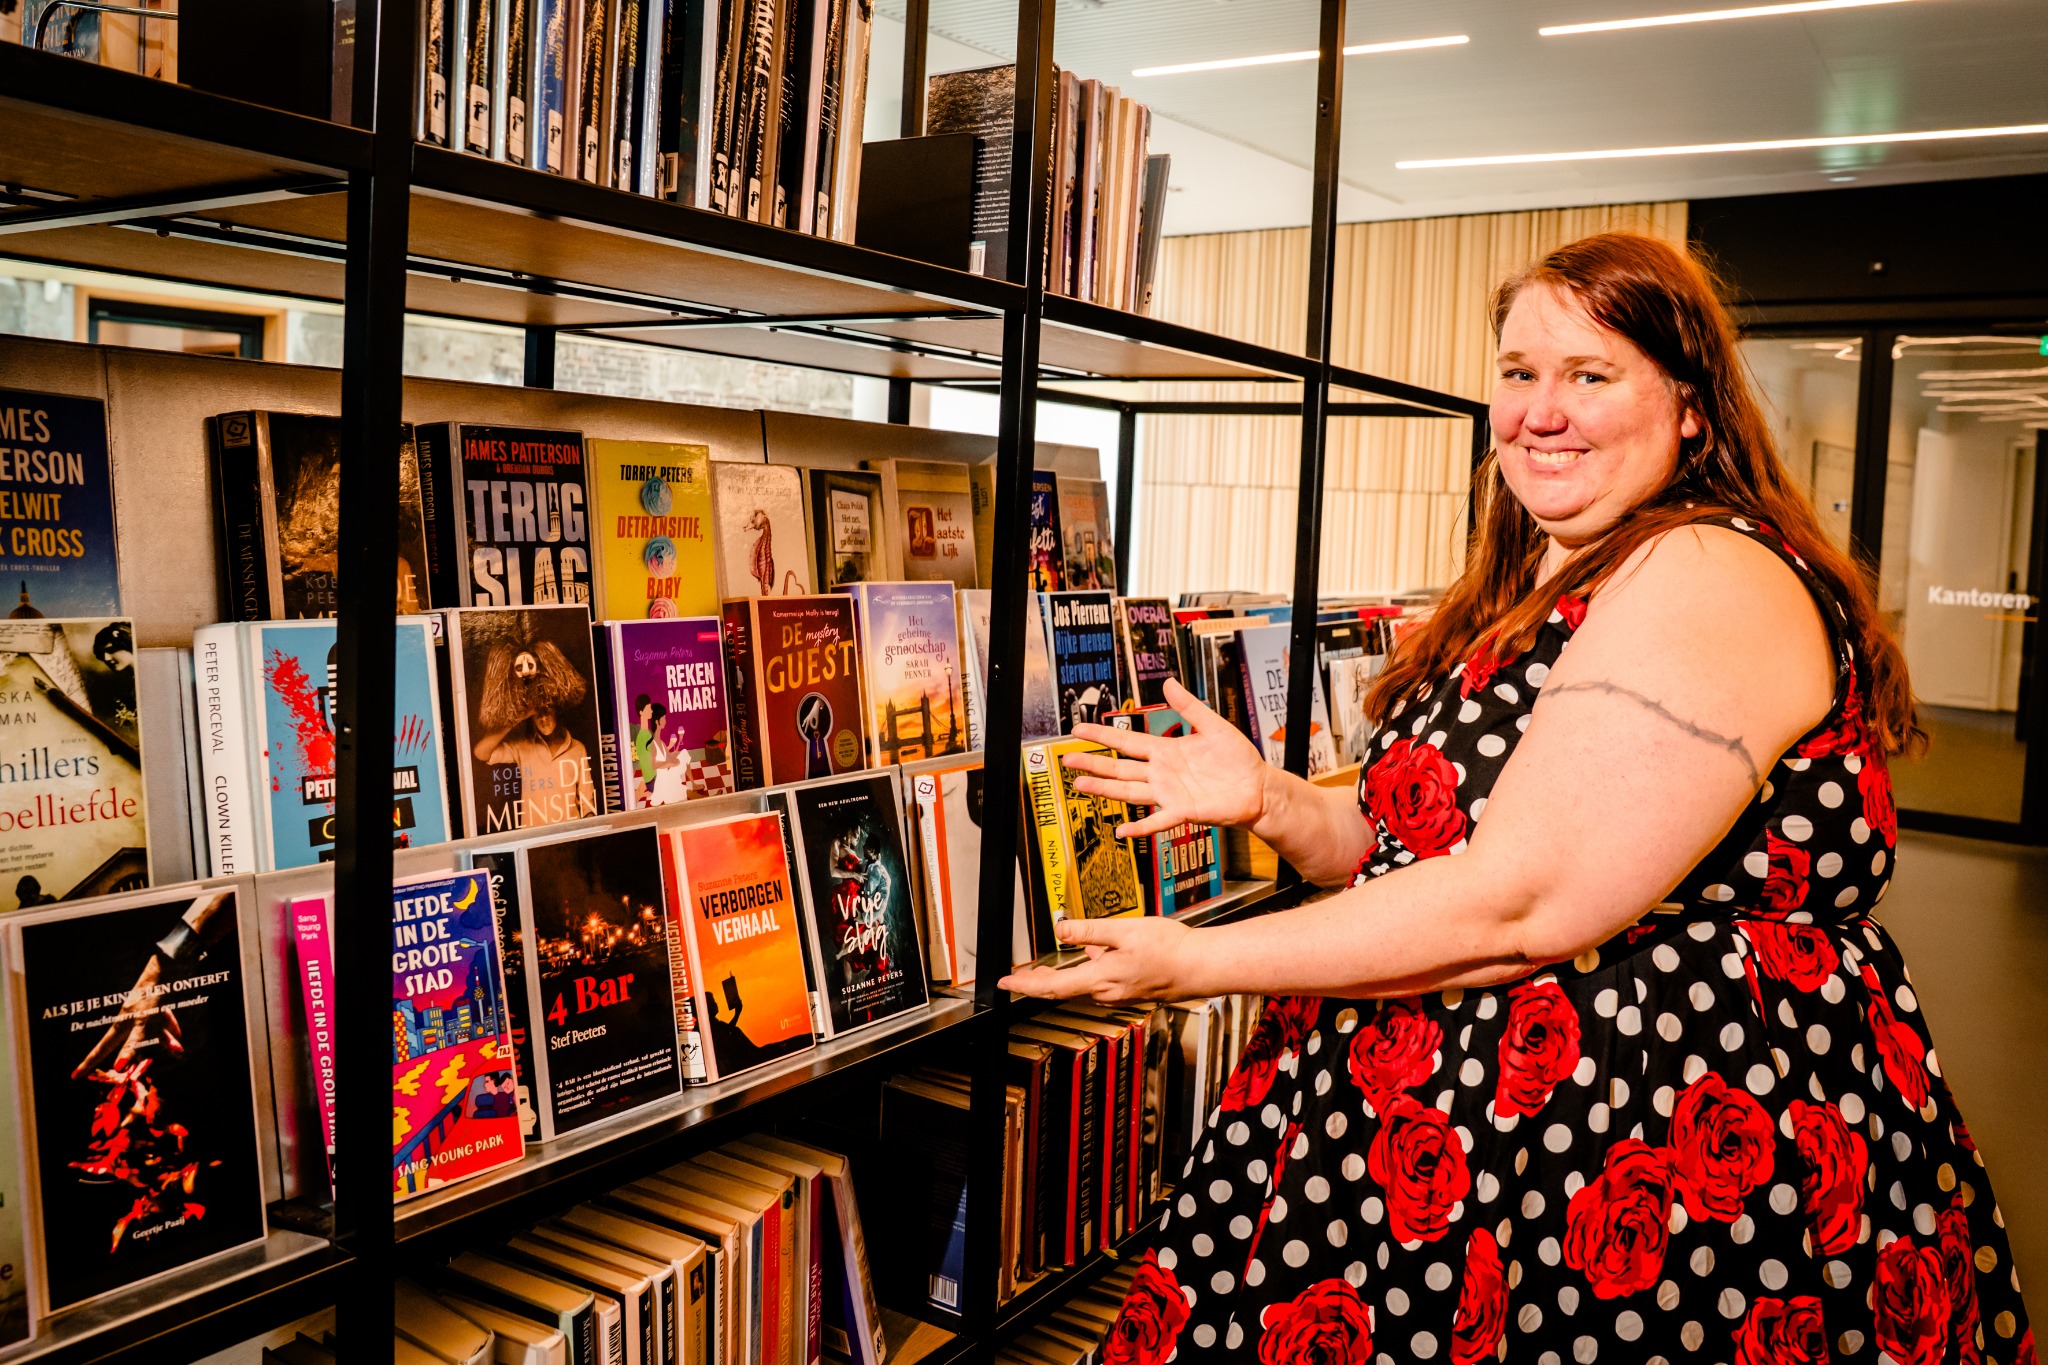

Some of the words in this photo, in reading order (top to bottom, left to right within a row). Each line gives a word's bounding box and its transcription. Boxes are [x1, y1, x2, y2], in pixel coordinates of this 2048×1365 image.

[628, 2, 640, 67] DUBBELSPEL
[553, 41, 564, 80] CROSS
[591, 100, 599, 129] CROS
[723, 81, 731, 151] DOODSVONNIS
[758, 87, 767, 134] SANDRA
[0, 408, 50, 443] MES
[419, 440, 432, 470] JAMES
[465, 438, 507, 462] JAMES
[511, 441, 581, 465] PATTERSON
[0, 450, 84, 486] ERSON
[503, 464, 532, 475] BRENDAN
[533, 465, 555, 476] DUBOIS
[620, 464, 658, 482] TORREY
[660, 467, 693, 484] PETERS
[421, 472, 435, 521] PATTERSON
[1033, 482, 1053, 492] ERSEN
[0, 491, 62, 521] ELWIT
[467, 479, 586, 543] TERUG
[937, 507, 952, 522] Het
[11, 527, 85, 558] CROSS
[238, 523, 251, 541] DE
[617, 515, 703, 542] DETRANSITIE,
[239, 545, 259, 621] MENSENGEN
[305, 574, 337, 591] KOE
[472, 547, 590, 607] SLAG
[646, 576, 682, 600] BABY
[1928, 585, 2031, 611] Kantoren
[908, 615, 924, 627] Het
[1053, 600, 1070, 627] Jos
[1070, 600, 1110, 626] Pierreux
[1128, 606, 1170, 624] OVERAL
[726, 622, 735, 660] PROSE
[737, 626, 746, 656] NITA
[782, 622, 803, 649] DE
[805, 623, 840, 647] mystery
[897, 627, 932, 642] geheime
[1055, 630, 1078, 660] Rijke
[1079, 632, 1112, 653] mensen
[205, 642, 219, 683] PETER
[633, 648, 670, 666] Suzanne
[670, 646, 694, 660] Peters
[766, 639, 854, 694] GUEST
[885, 639, 946, 665] genootschap
[906, 659, 929, 668] SARAH
[1135, 653, 1167, 671] MENS
[665, 662, 715, 689] REKEN
[904, 669, 932, 679] PENNER
[1060, 663, 1094, 685] sterven
[1094, 657, 1112, 680] niet
[1266, 668, 1284, 691] DE
[667, 686, 718, 713] MAAR!
[737, 703, 747, 716] DE
[207, 686, 224, 755] PERCEVAL
[969, 722, 981, 749] ONS
[0, 747, 100, 784] hillers
[558, 756, 594, 788] DE
[601, 734, 619, 782] REKEN
[739, 757, 754, 784] GUE
[492, 767, 533, 781] KOEN
[494, 778, 555, 798] PEETERS
[215, 775, 230, 829] CLOWN
[305, 780, 336, 799] PET
[486, 790, 598, 834] MENSEN
[1047, 840, 1059, 868] NINA
[1161, 835, 1216, 880] EUROPA
[697, 876, 733, 893] Suzanne
[733, 871, 758, 884] Peters
[1051, 873, 1067, 909] POLAK
[1174, 877, 1195, 893] LEONARD
[393, 892, 454, 923] IEFDE
[700, 879, 784, 920] VERBORGEN
[837, 890, 883, 930] Vrije
[297, 923, 321, 932] Young
[298, 914, 317, 923] Sang
[395, 924, 418, 948] IN
[421, 918, 451, 942] DE
[712, 908, 781, 946] VERHAAL
[301, 932, 318, 941] Park
[843, 924, 889, 968] slag
[392, 940, 462, 974] GROTE
[666, 919, 689, 994] VERBORGEN
[42, 1003, 68, 1020] ALS
[70, 1000, 85, 1016] JE
[87, 997, 101, 1013] JE
[172, 970, 230, 992] ONTERFT
[306, 959, 325, 1010] LIEFDE
[405, 968, 453, 997] STAD
[842, 978, 876, 995] SUZANNE
[878, 969, 903, 984] PETERS
[70, 1022, 84, 1032] De
[177, 995, 209, 1009] moeder
[547, 992, 568, 1027] 4
[573, 972, 635, 1016] Bar
[312, 1012, 326, 1028] IN
[316, 1031, 330, 1052] DE
[550, 1030, 571, 1050] Stef
[571, 1024, 607, 1045] Peeters
[398, 1158, 428, 1178] SANG
[430, 1145, 473, 1169] YOUNG
[475, 1134, 504, 1154] PARK
[132, 1223, 164, 1240] Geertje
[810, 1263, 818, 1301] NAAR
[781, 1284, 791, 1329] VOOR
[583, 1318, 591, 1364] Monika
[608, 1319, 621, 1355] MARNIX
